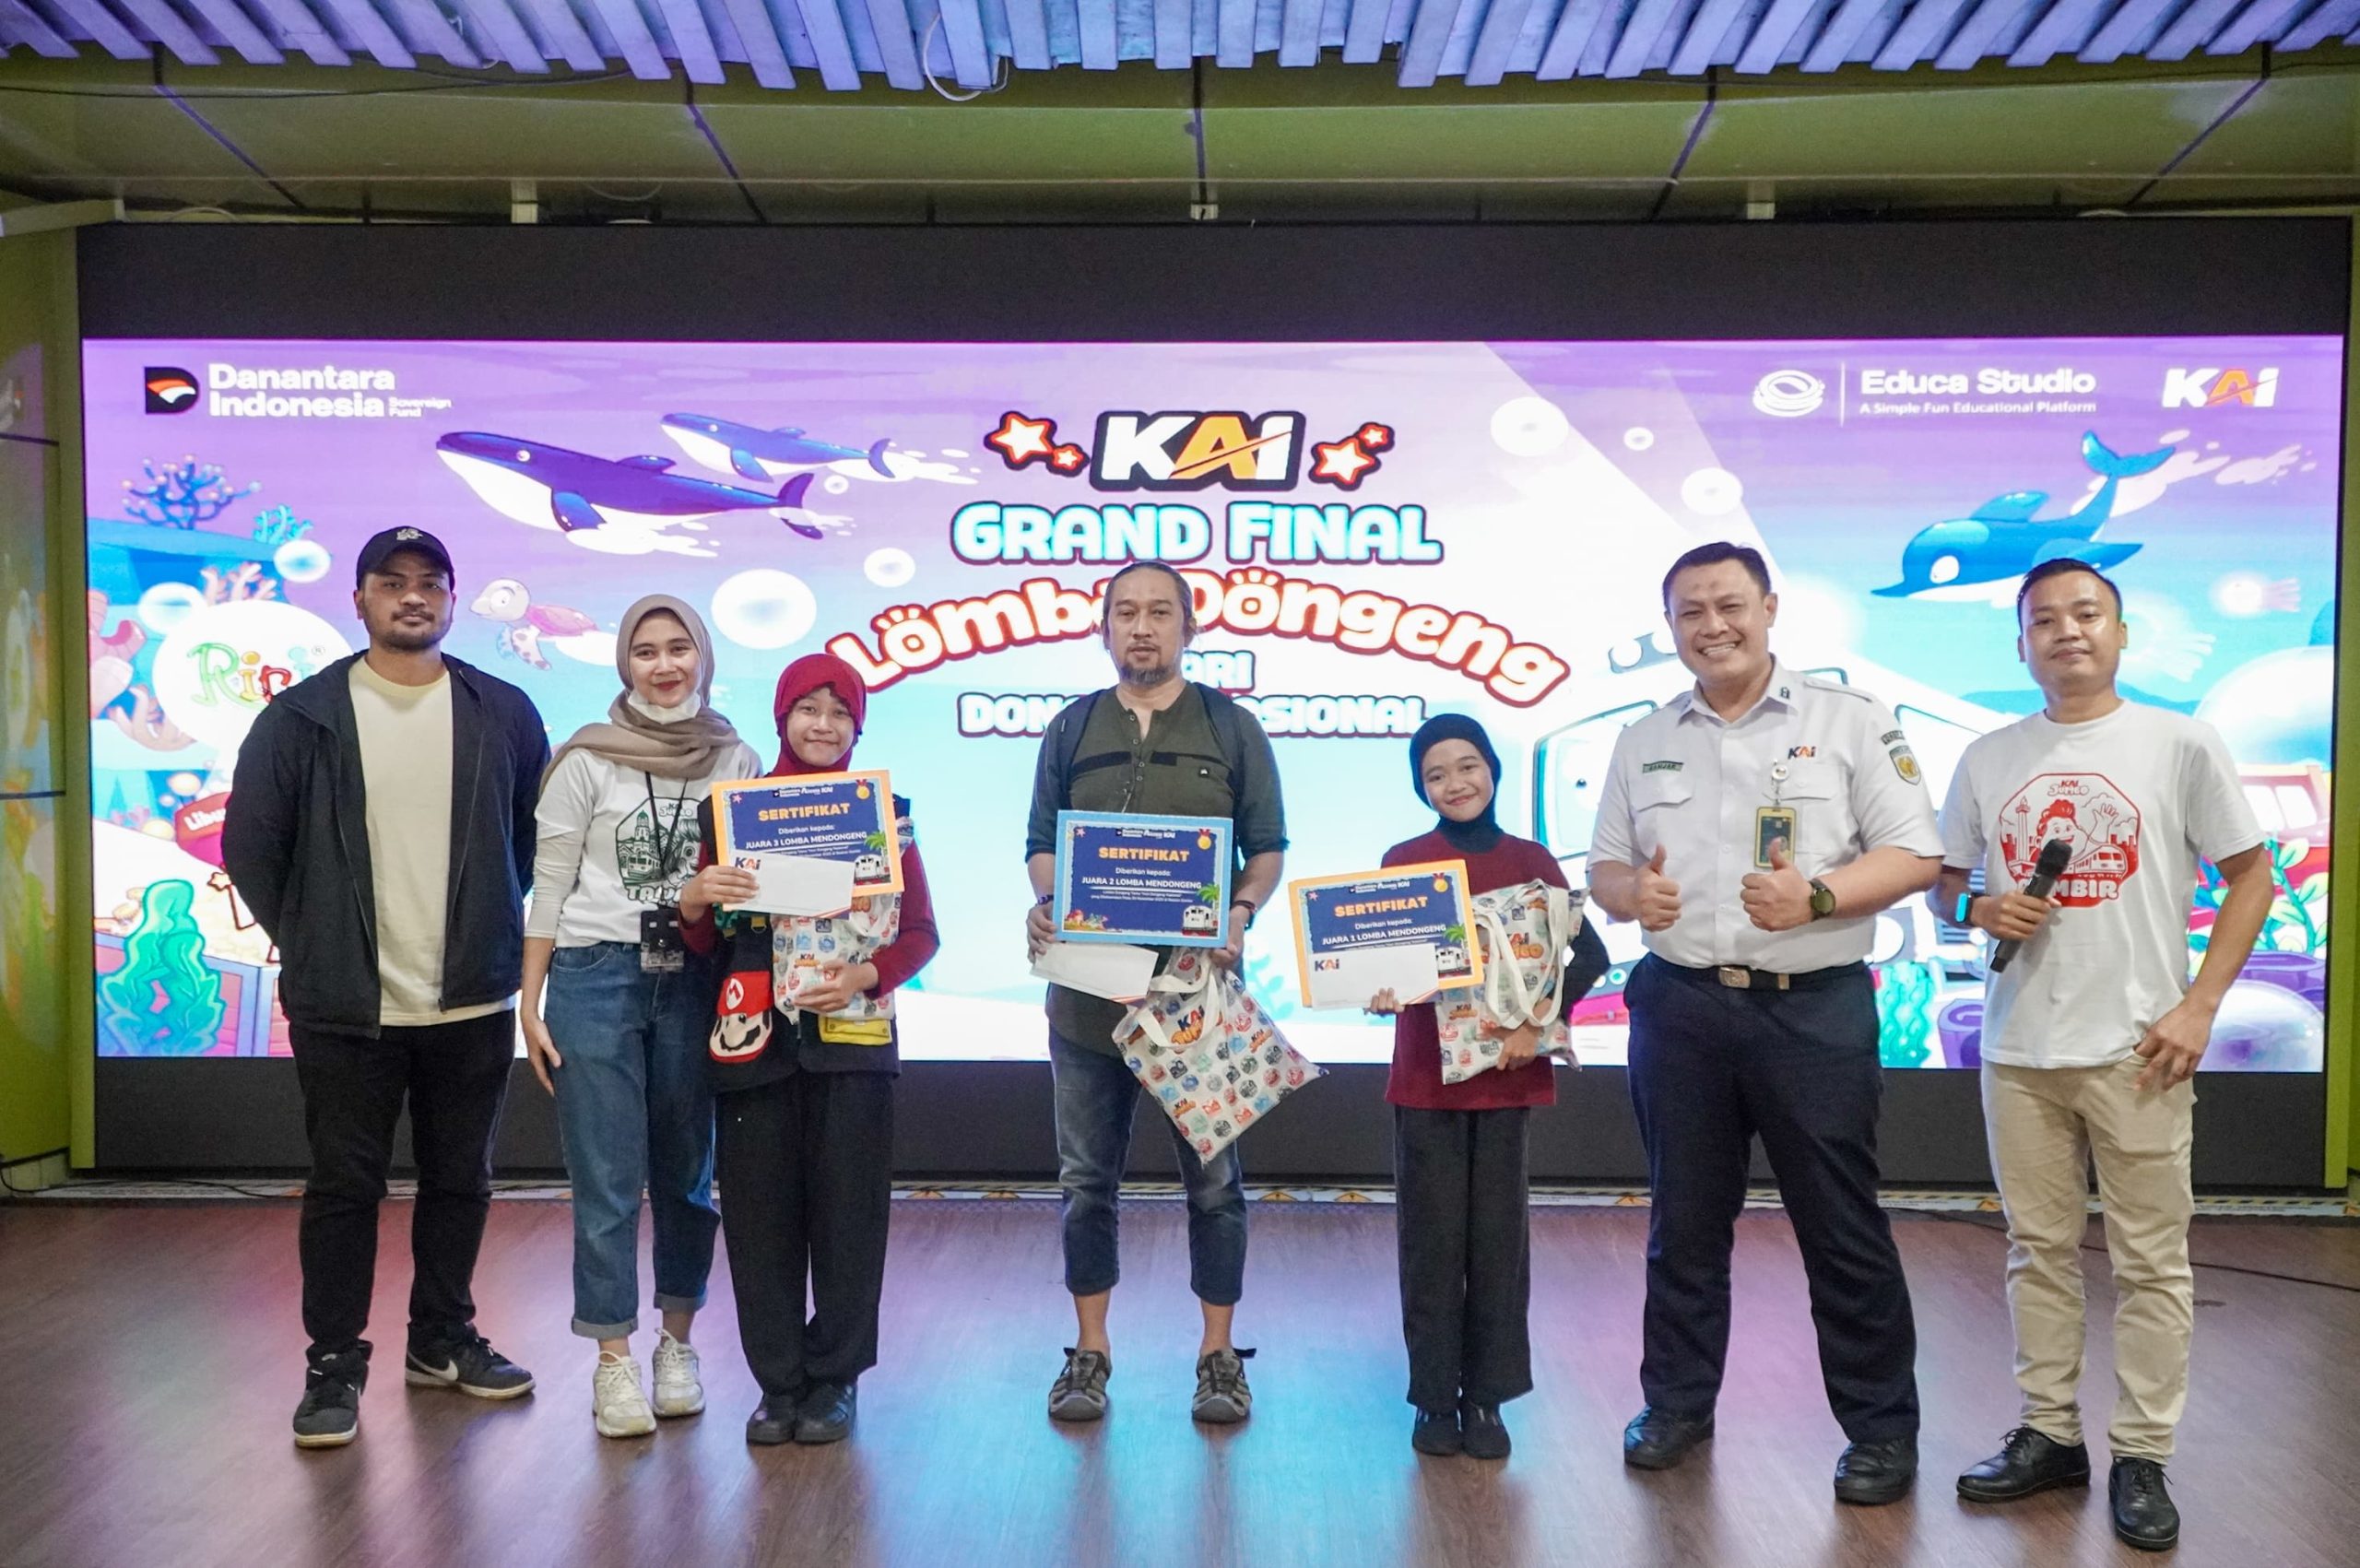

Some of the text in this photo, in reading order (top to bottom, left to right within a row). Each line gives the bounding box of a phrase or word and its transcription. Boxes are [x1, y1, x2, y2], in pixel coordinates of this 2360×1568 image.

[207, 363, 395, 390] Danantara
[1861, 369, 2096, 394] Educa Studio
[2163, 367, 2279, 407] KAI
[208, 392, 384, 417] Indonesia
[1859, 401, 2096, 416] A Simple Fun Educational Platform
[1102, 415, 1293, 481] KAI
[952, 501, 1443, 564] GRAND FINAL
[759, 803, 850, 821] SERTIFIKAT
[746, 840, 773, 849] JUARA
[781, 837, 809, 846] LOMBA
[811, 831, 867, 843] MENDONGENG
[1098, 846, 1190, 862] SERTIFIKAT
[1082, 877, 1107, 885] JUARA
[1115, 878, 1144, 886] LOMBA
[1146, 879, 1202, 889] MENDONGENG
[2018, 878, 2119, 899] MBIR
[1334, 896, 1428, 917] SERTIFIKAT
[1322, 937, 1349, 946] JUARA
[1357, 932, 1386, 941] LOMBA
[1388, 924, 1446, 937] MENDONGENG
